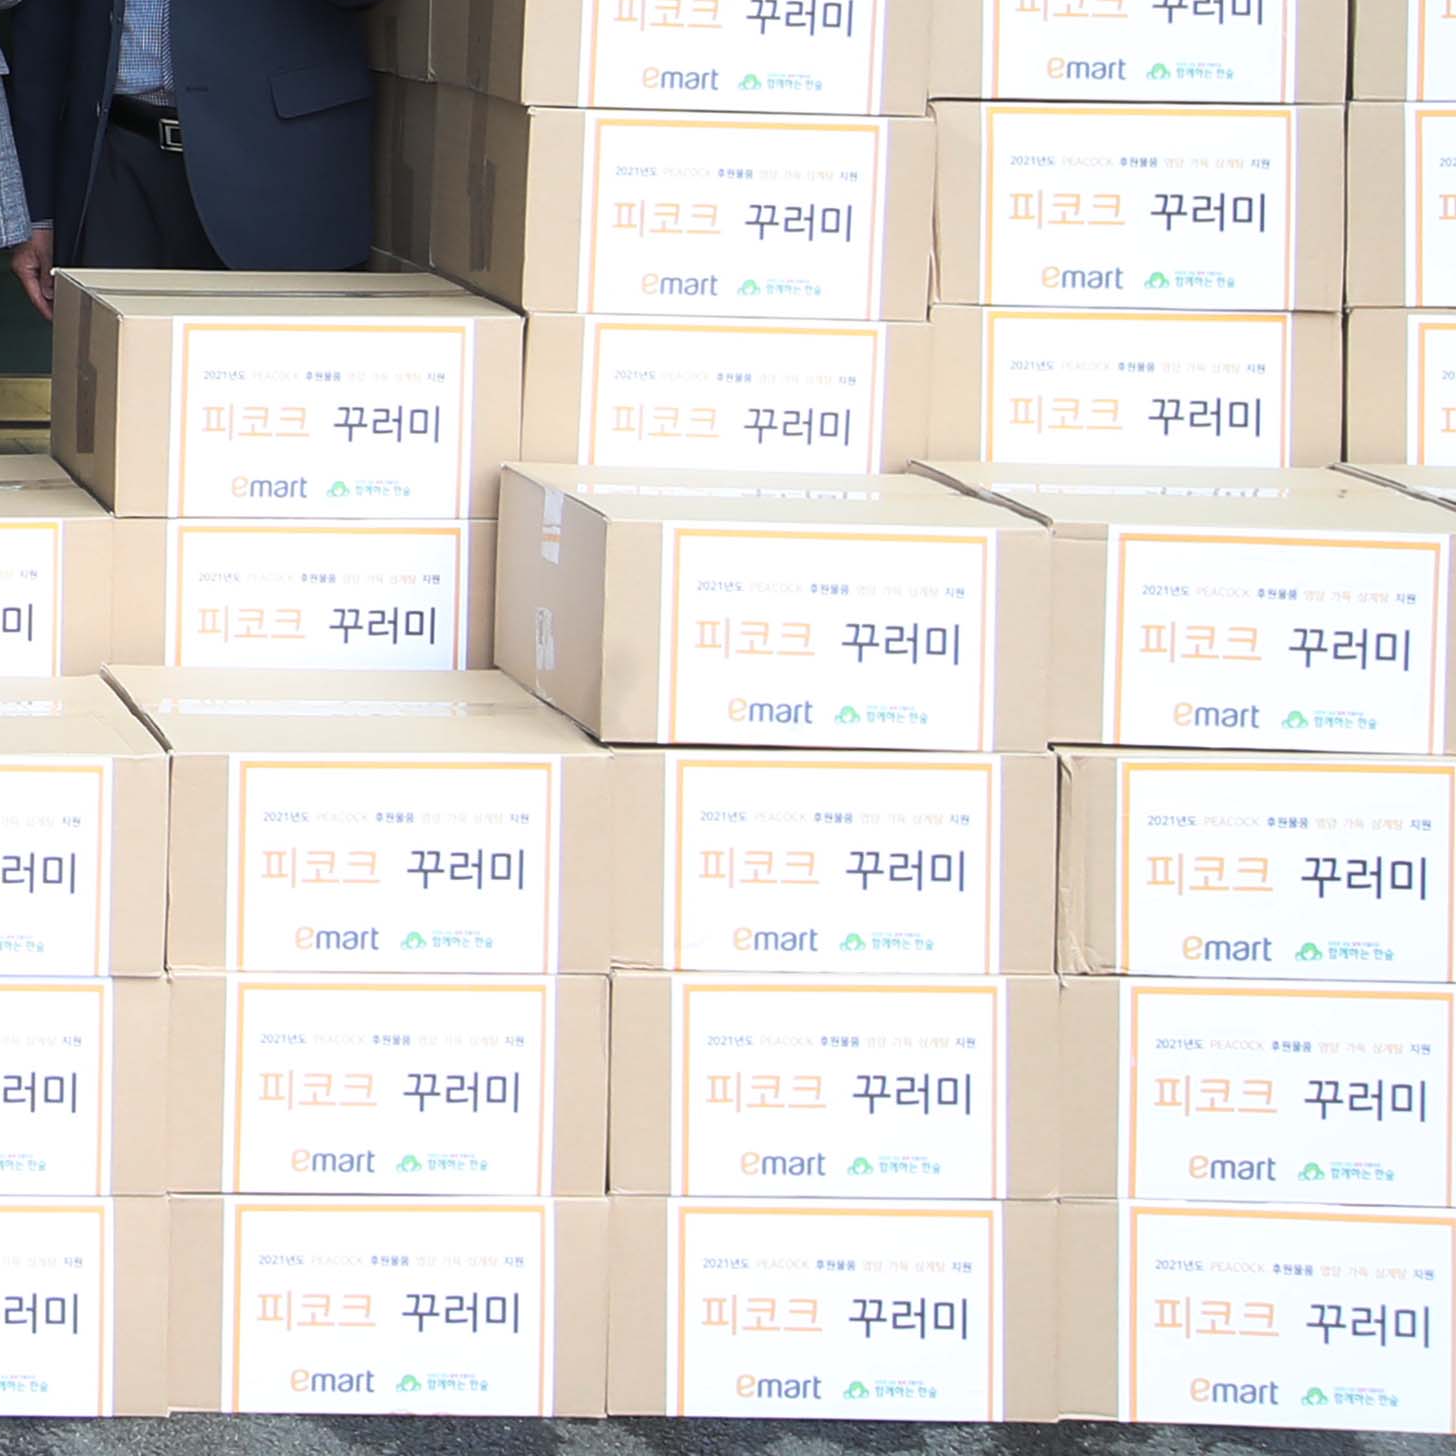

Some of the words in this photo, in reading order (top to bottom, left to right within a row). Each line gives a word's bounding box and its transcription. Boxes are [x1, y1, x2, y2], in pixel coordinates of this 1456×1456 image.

[642, 64, 720, 91] emart
[1047, 54, 1128, 80] emart
[1010, 191, 1125, 228] 피코크
[1150, 192, 1266, 233] 꾸러미
[1041, 263, 1125, 290] emart
[204, 405, 309, 440] 피코크
[333, 405, 440, 443] 꾸러미
[231, 473, 309, 498] emart
[1142, 584, 1190, 597] 2021년도
[1141, 622, 1261, 662] 피코크
[1288, 628, 1410, 672] 꾸러미
[1173, 700, 1261, 729] emart
[263, 848, 379, 888] 피코크
[406, 848, 524, 890] 꾸러미
[1147, 854, 1273, 896] 피코크
[1301, 856, 1427, 901] 꾸러미
[295, 924, 380, 951] emart
[1182, 933, 1273, 962] emart
[707, 1072, 826, 1112] 피코크
[852, 1073, 971, 1116] 꾸러미
[740, 1149, 827, 1176] emart
[1155, 1297, 1279, 1338] 피코크
[1306, 1304, 1430, 1349] 꾸러미
[1189, 1375, 1280, 1406] emart
